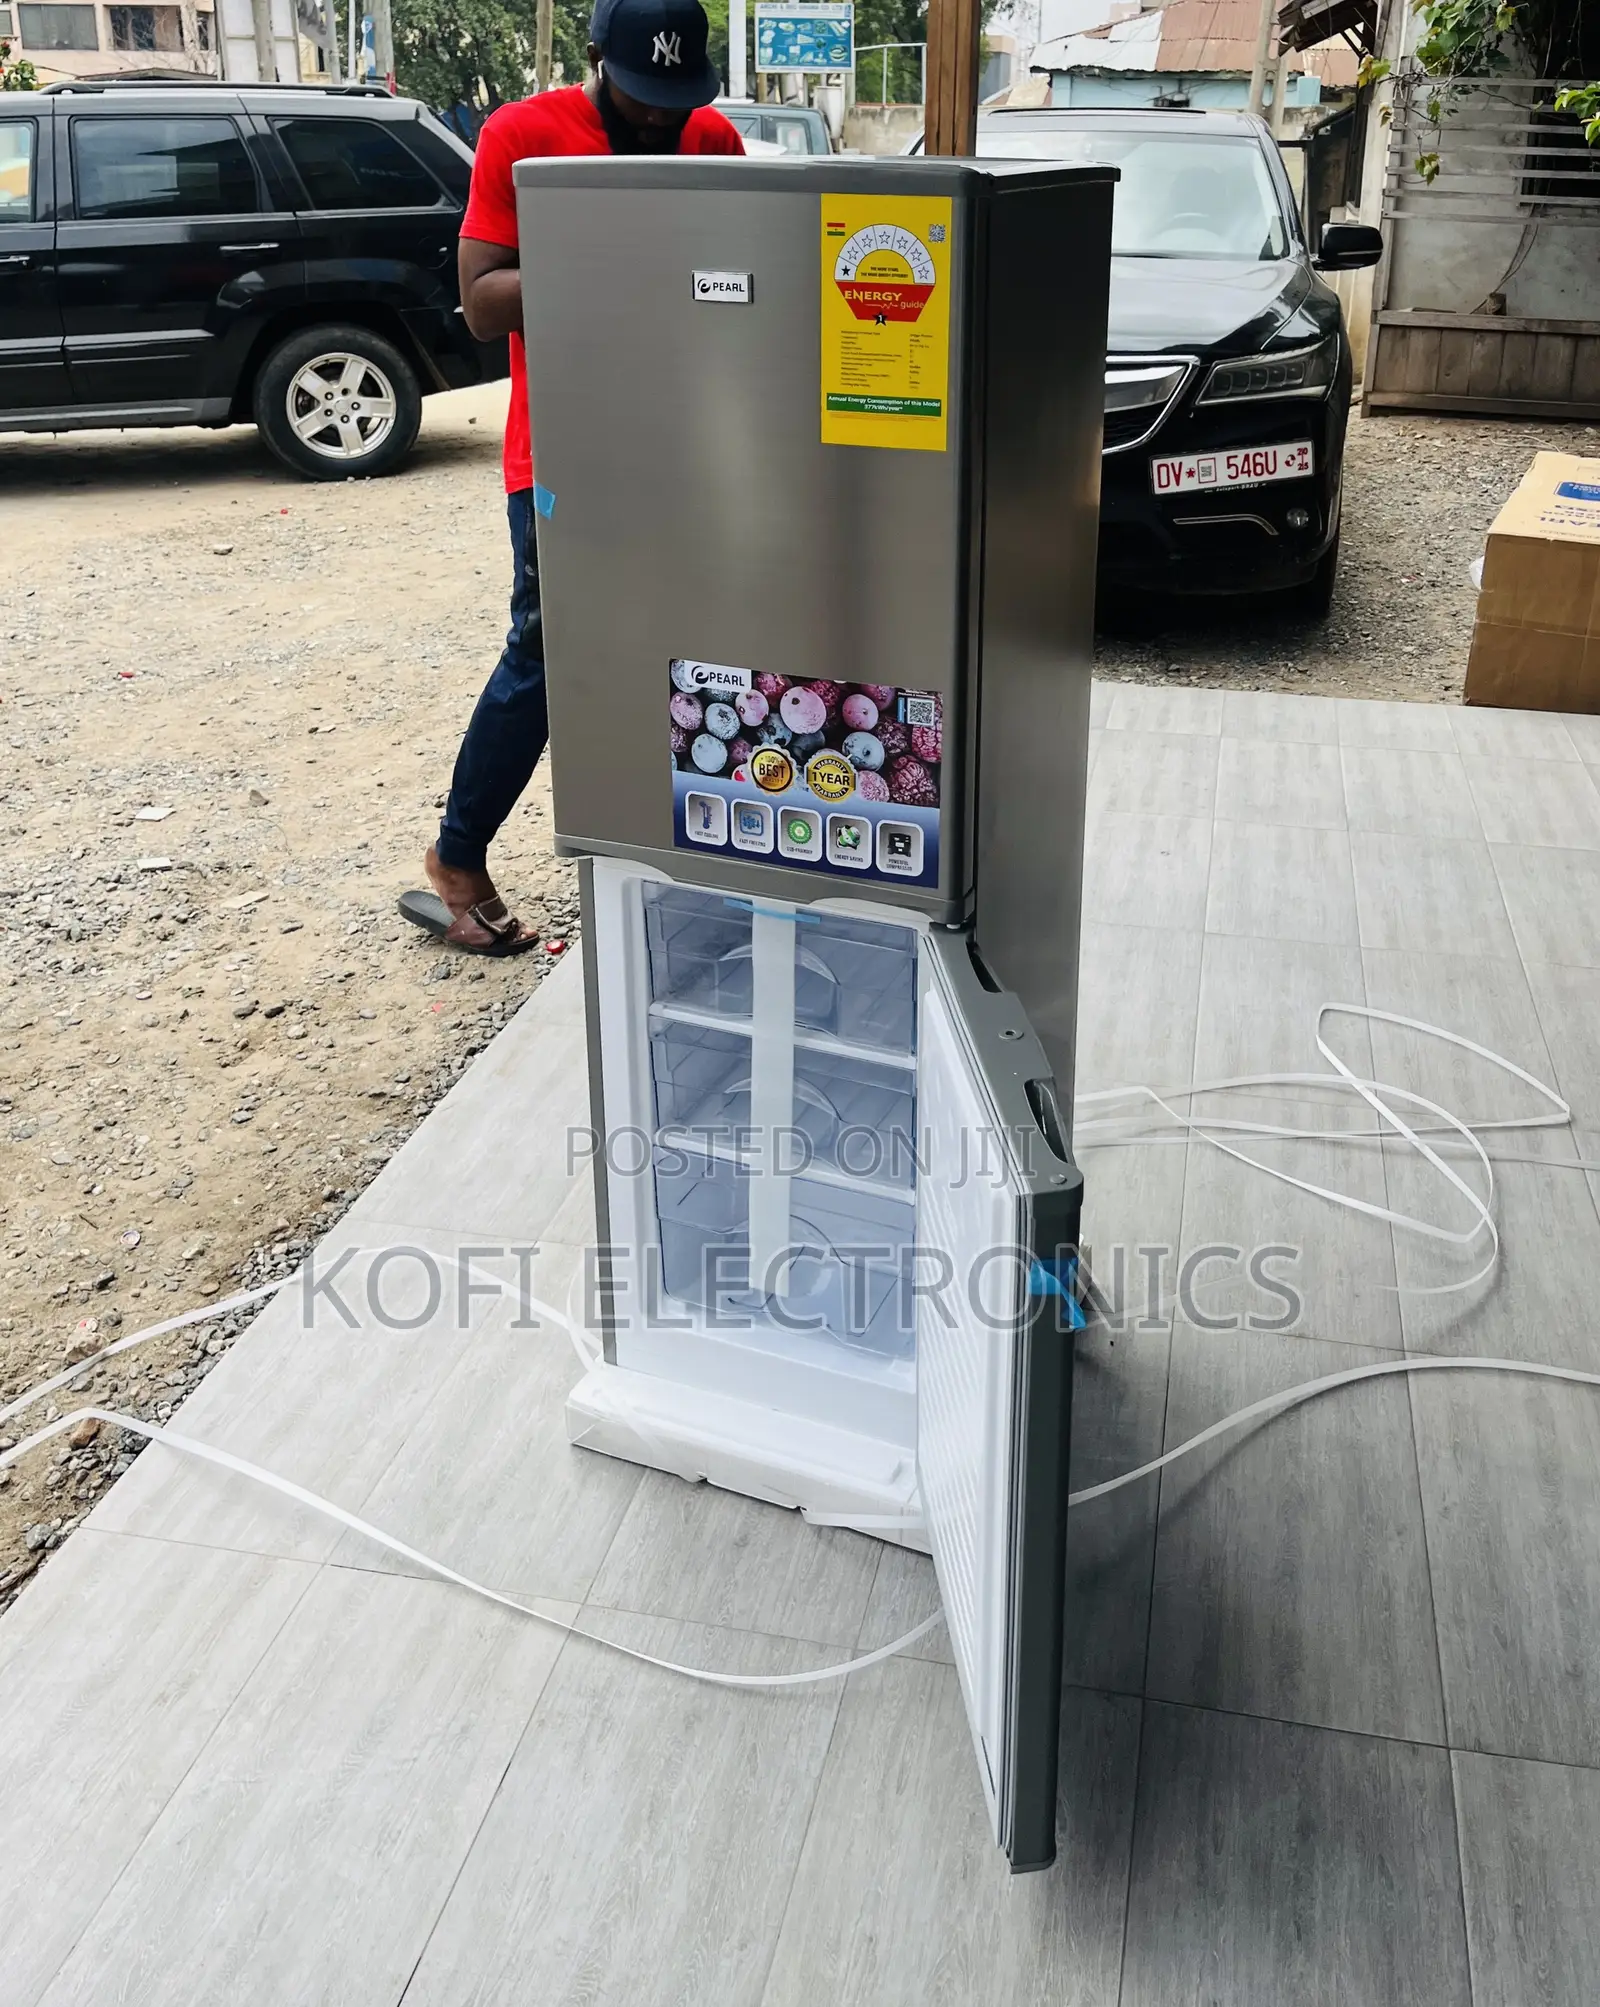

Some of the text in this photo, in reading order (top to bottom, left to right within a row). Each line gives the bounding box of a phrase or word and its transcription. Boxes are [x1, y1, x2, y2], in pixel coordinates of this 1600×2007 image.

[652, 31, 681, 66] NY
[712, 282, 745, 292] PEARL
[844, 289, 902, 303] ENERGY
[900, 300, 925, 309] guide
[867, 398, 903, 406] Consumption
[1157, 450, 1277, 489] DV 546U
[709, 671, 745, 687] PEARL
[759, 763, 785, 778] BEST
[815, 758, 848, 773] WARRANTY
[819, 772, 850, 786] YEAR
[815, 784, 847, 798] WARRANTY
